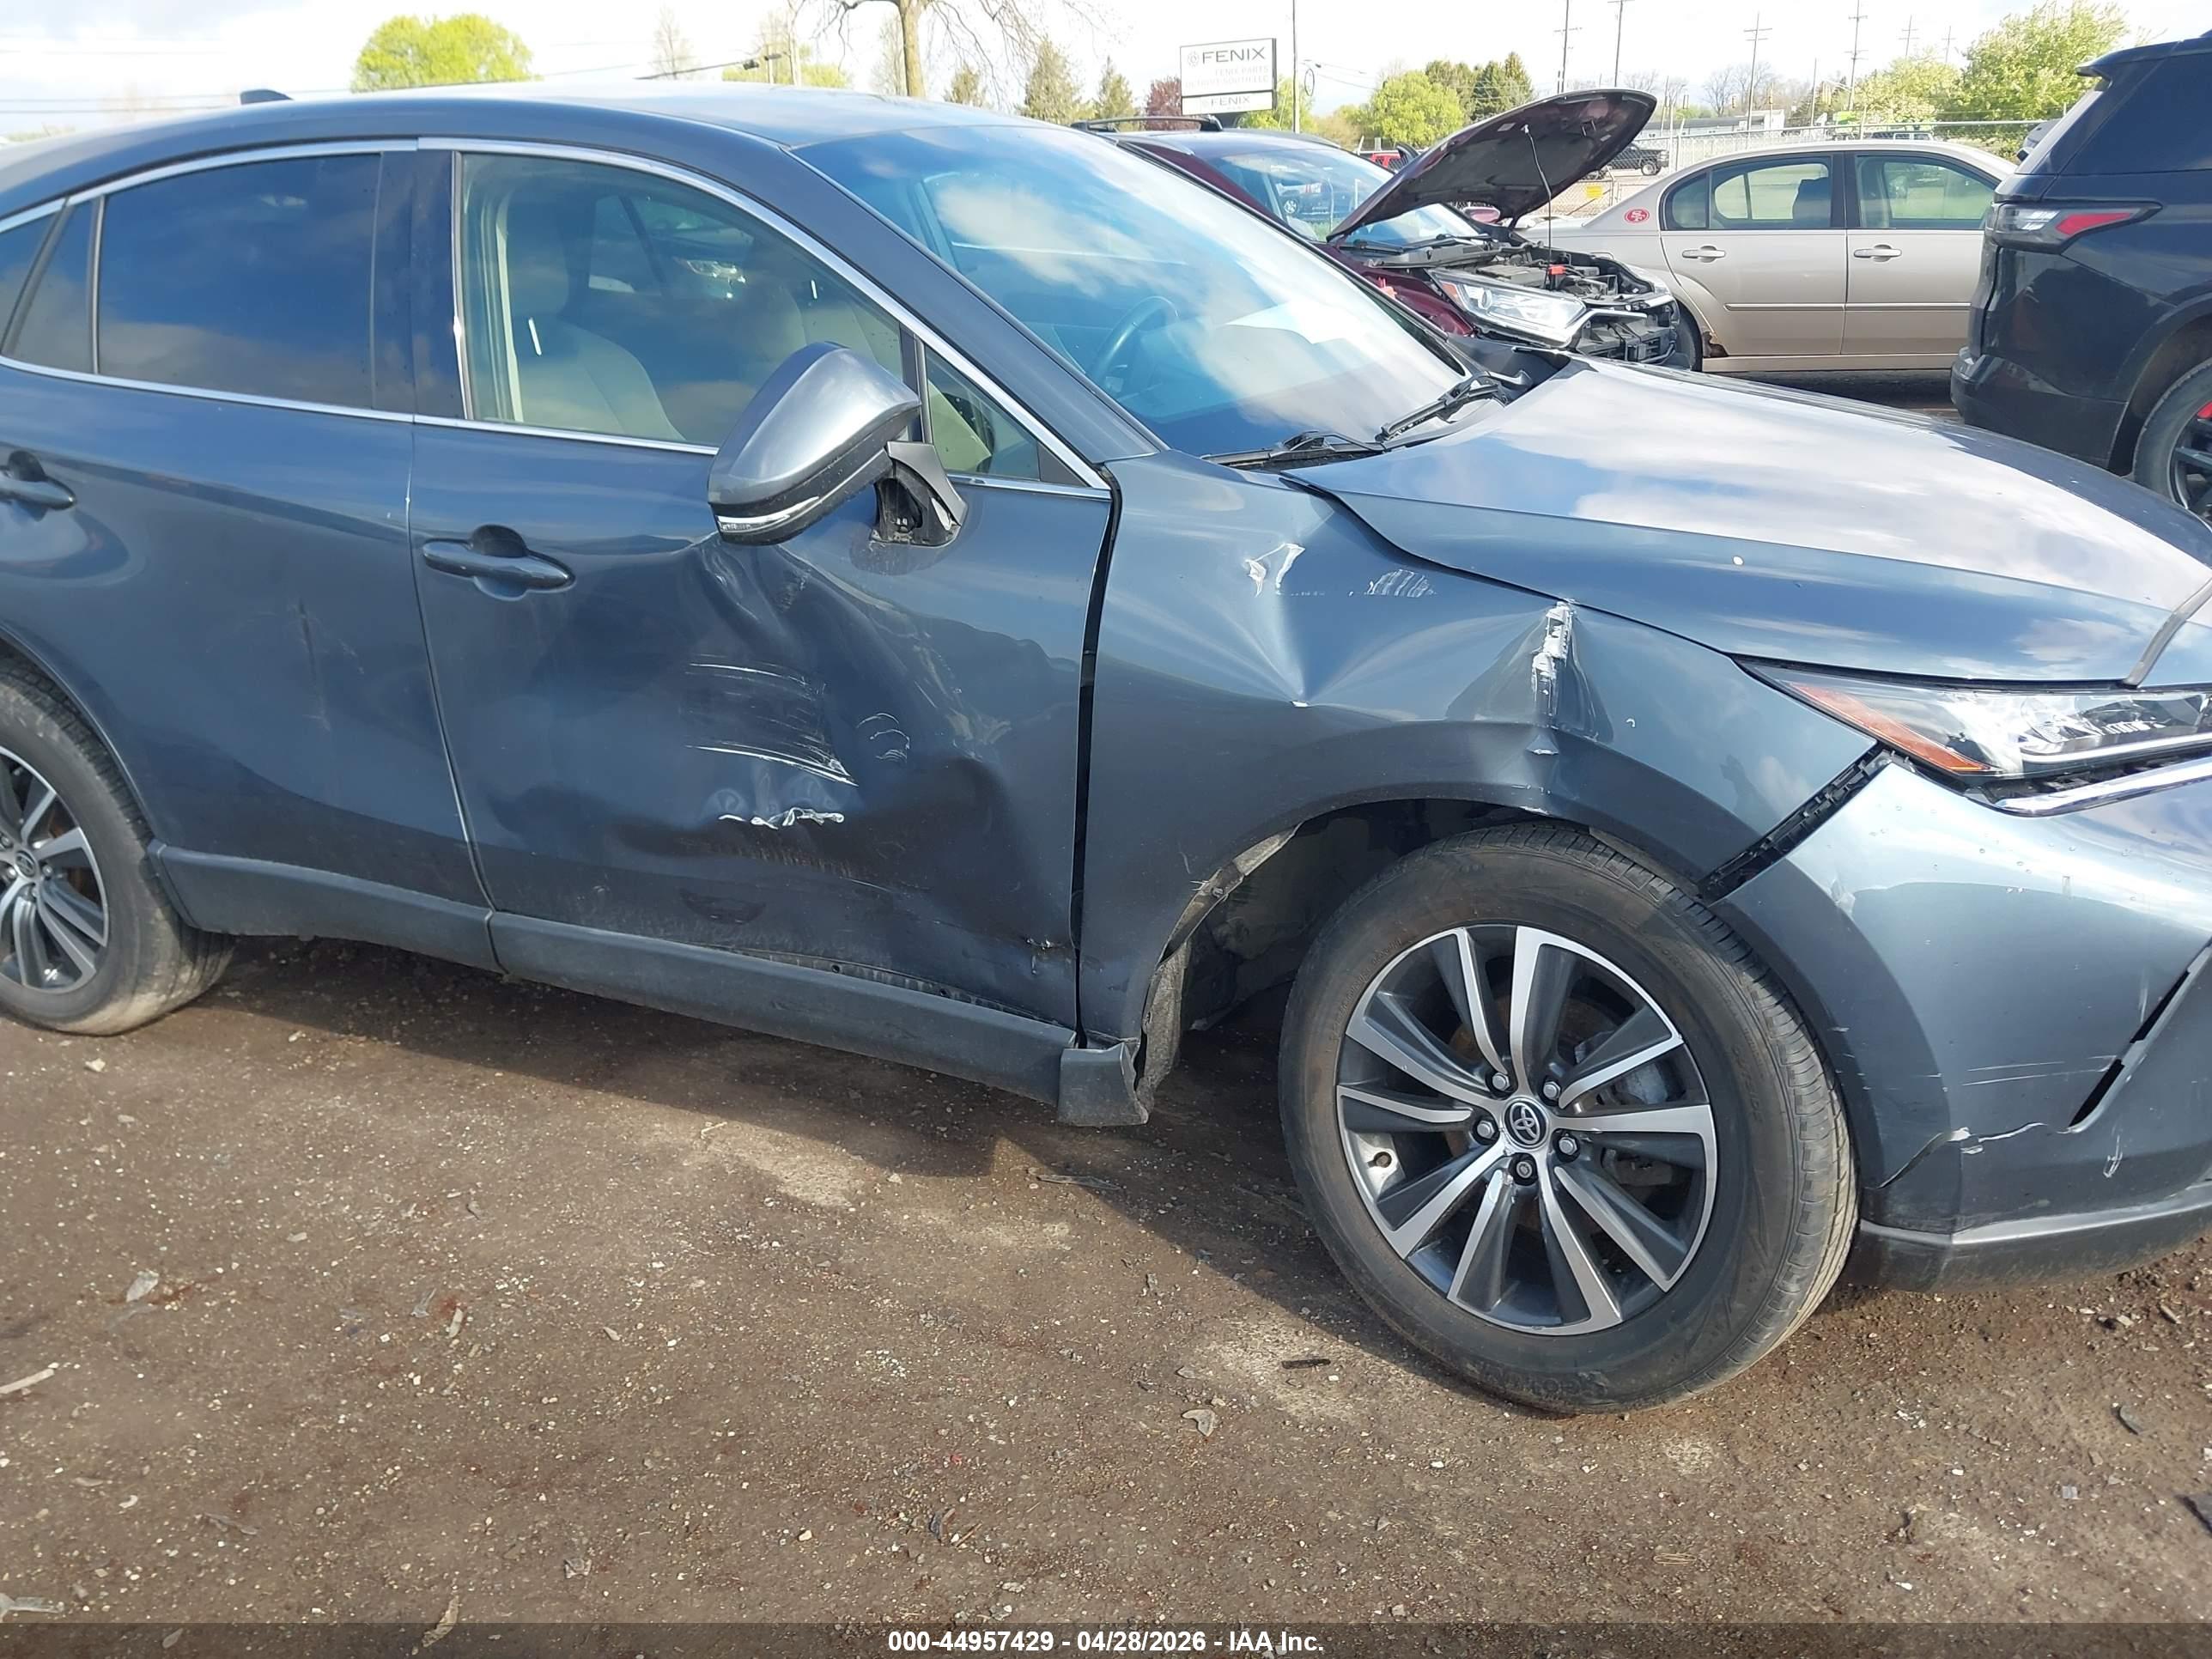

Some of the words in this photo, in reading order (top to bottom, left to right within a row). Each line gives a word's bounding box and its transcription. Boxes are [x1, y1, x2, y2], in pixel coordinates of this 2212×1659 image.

[1202, 46, 1266, 64] FENIX
[1215, 68, 1238, 76] FENIX
[1242, 65, 1268, 74] PARTS
[1211, 96, 1250, 106] FENIX
